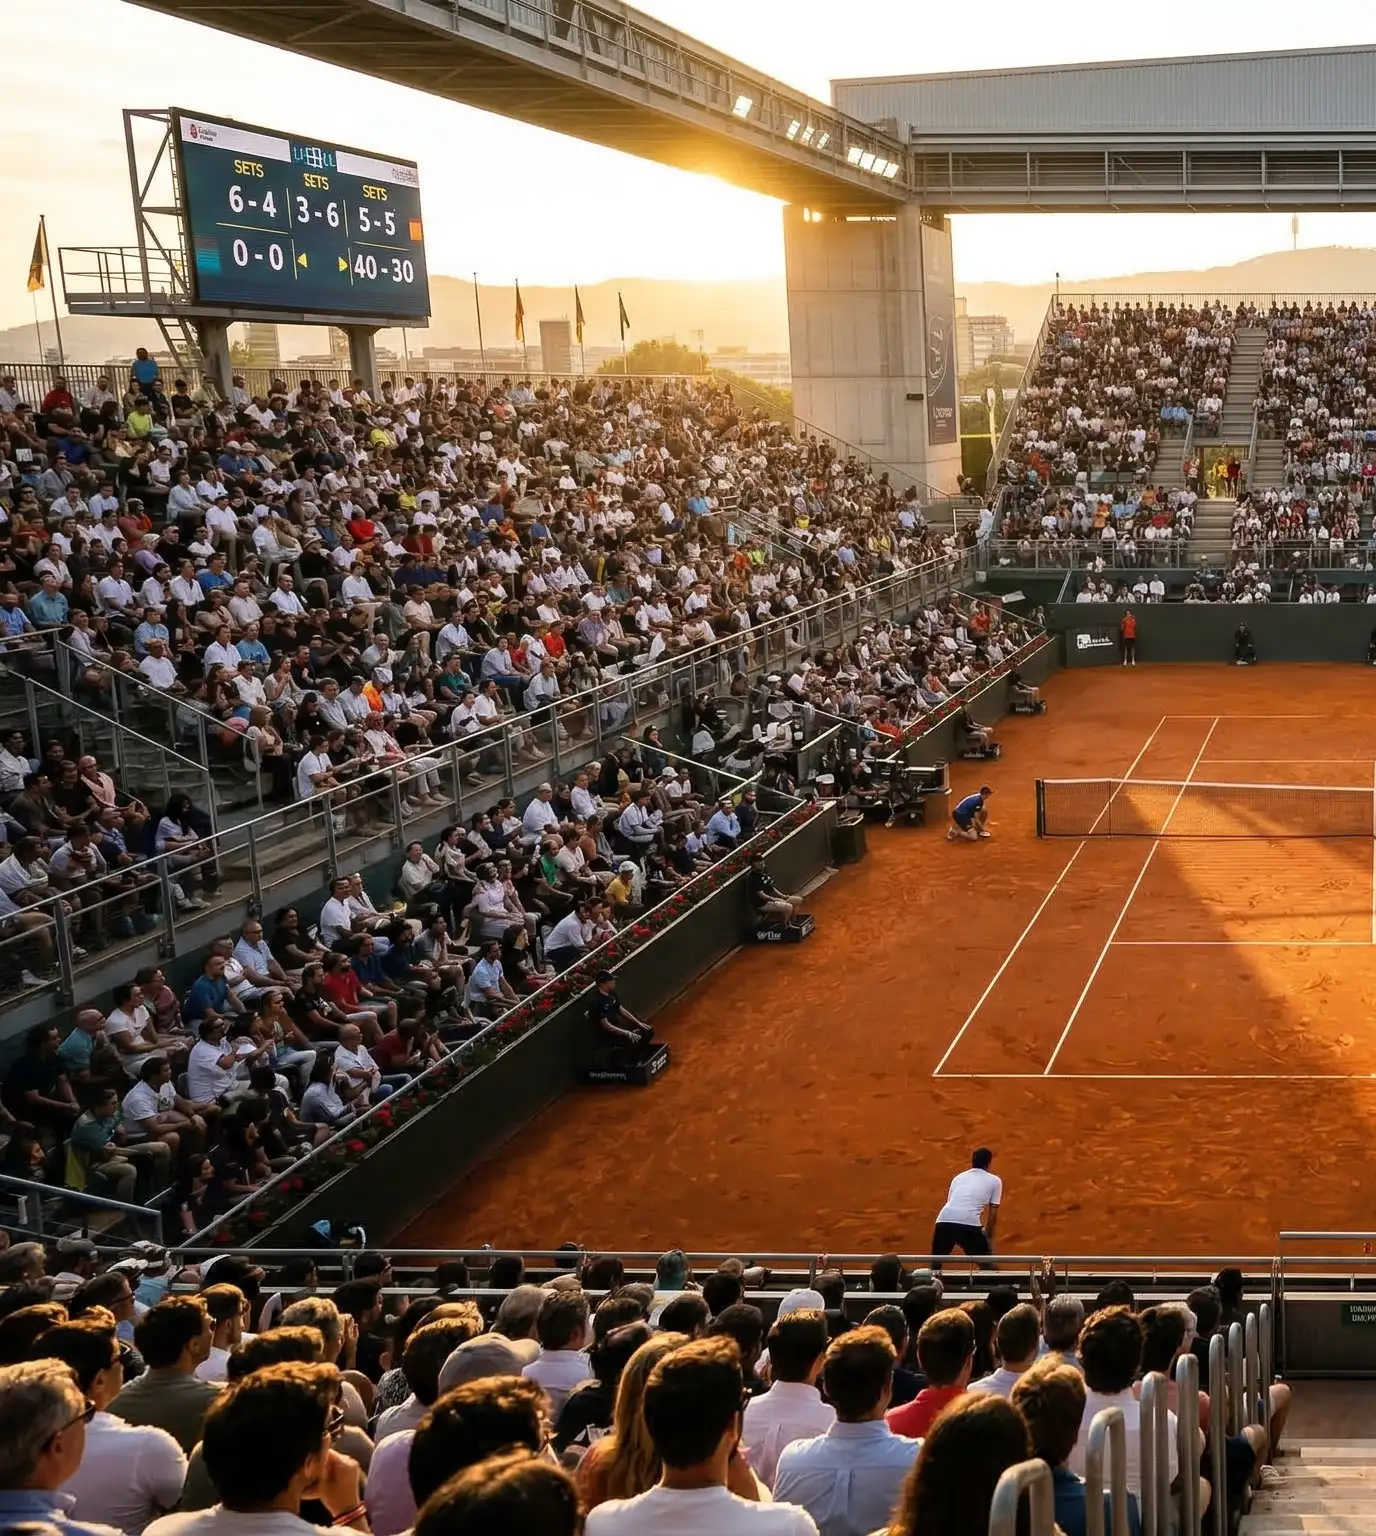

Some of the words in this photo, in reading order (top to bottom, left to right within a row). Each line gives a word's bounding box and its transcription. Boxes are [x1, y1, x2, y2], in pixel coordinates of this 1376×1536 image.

[234, 160, 264, 177] SETS
[303, 173, 329, 191] SETS
[362, 185, 388, 201] SETS
